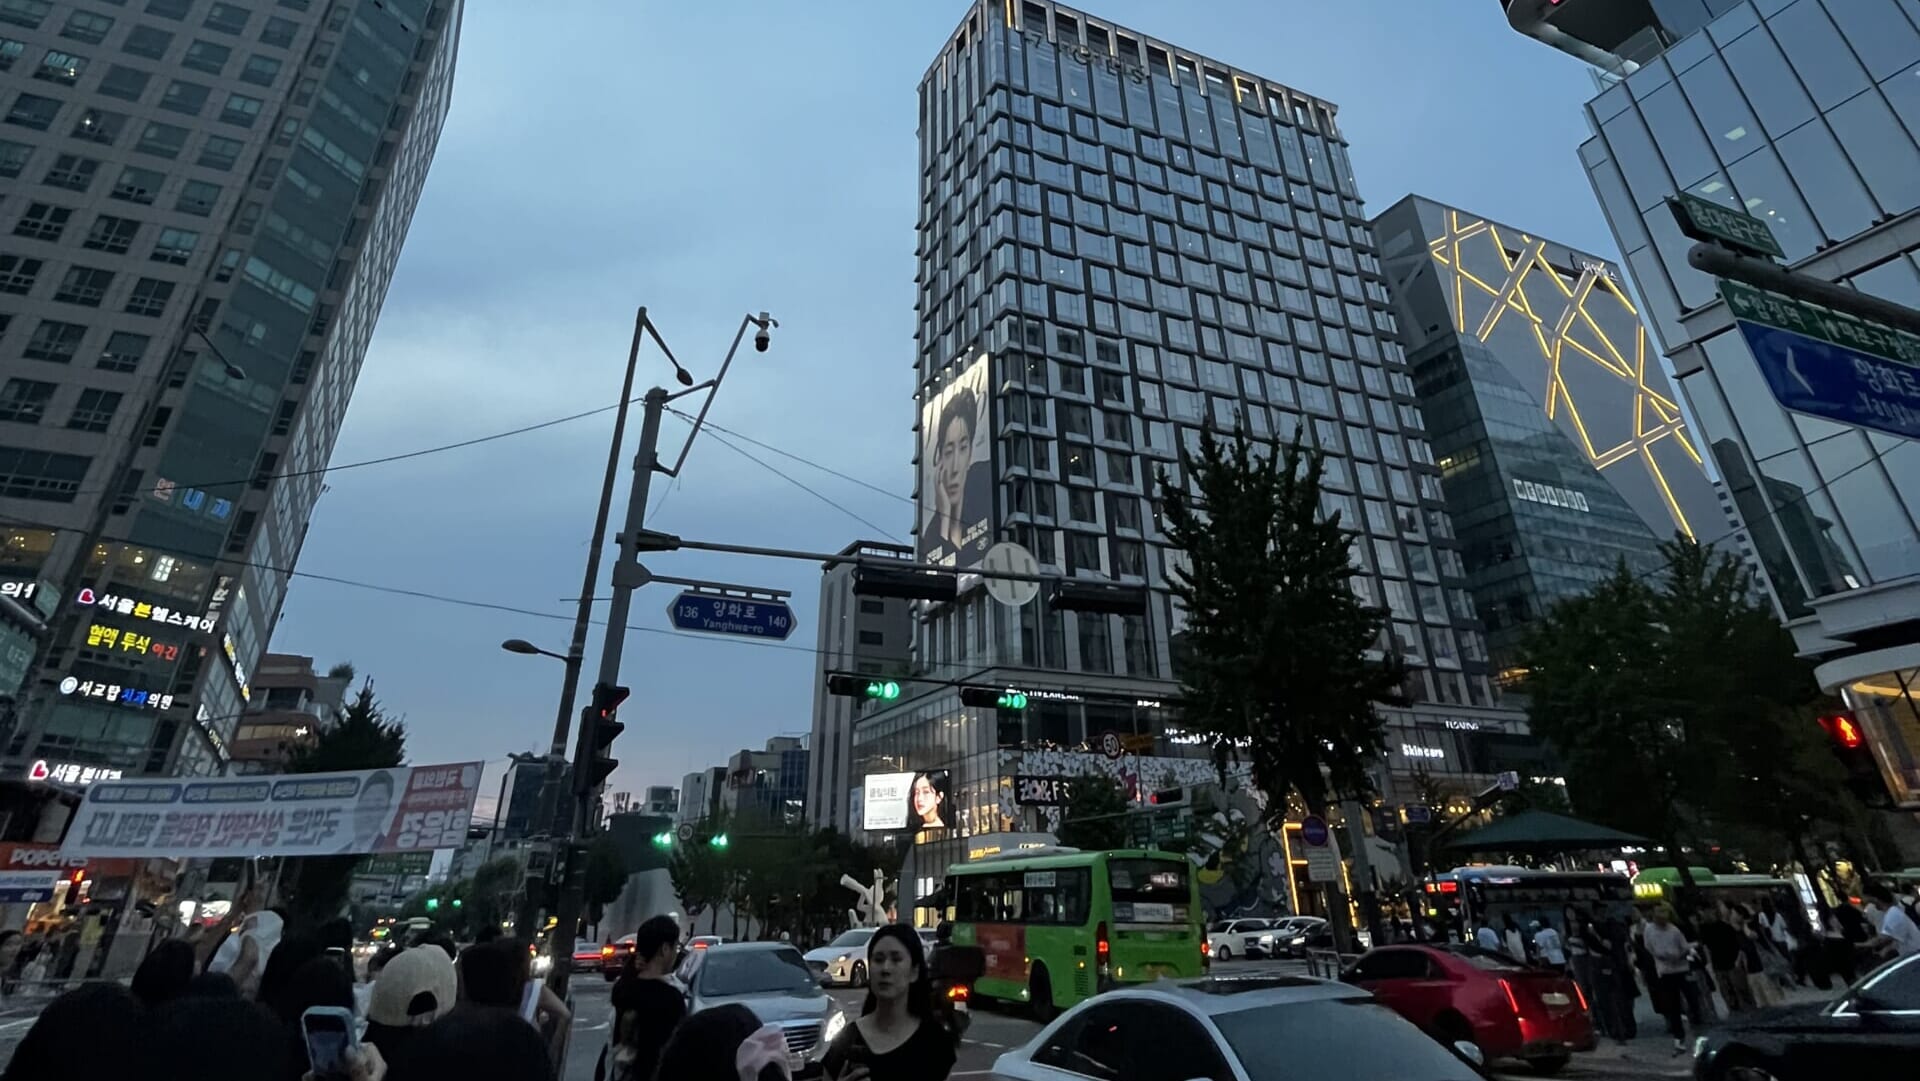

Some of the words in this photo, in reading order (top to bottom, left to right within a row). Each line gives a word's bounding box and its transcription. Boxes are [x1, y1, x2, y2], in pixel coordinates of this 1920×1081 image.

[1688, 199, 1776, 248] 홍대입구역
[1750, 293, 1807, 331] 합정역
[678, 605, 699, 619] 136
[713, 601, 757, 619] 양화로
[768, 615, 787, 628] 140
[703, 618, 764, 634] Yanghwa-ro
[87, 623, 120, 650] 혈액
[120, 631, 152, 657] 투석
